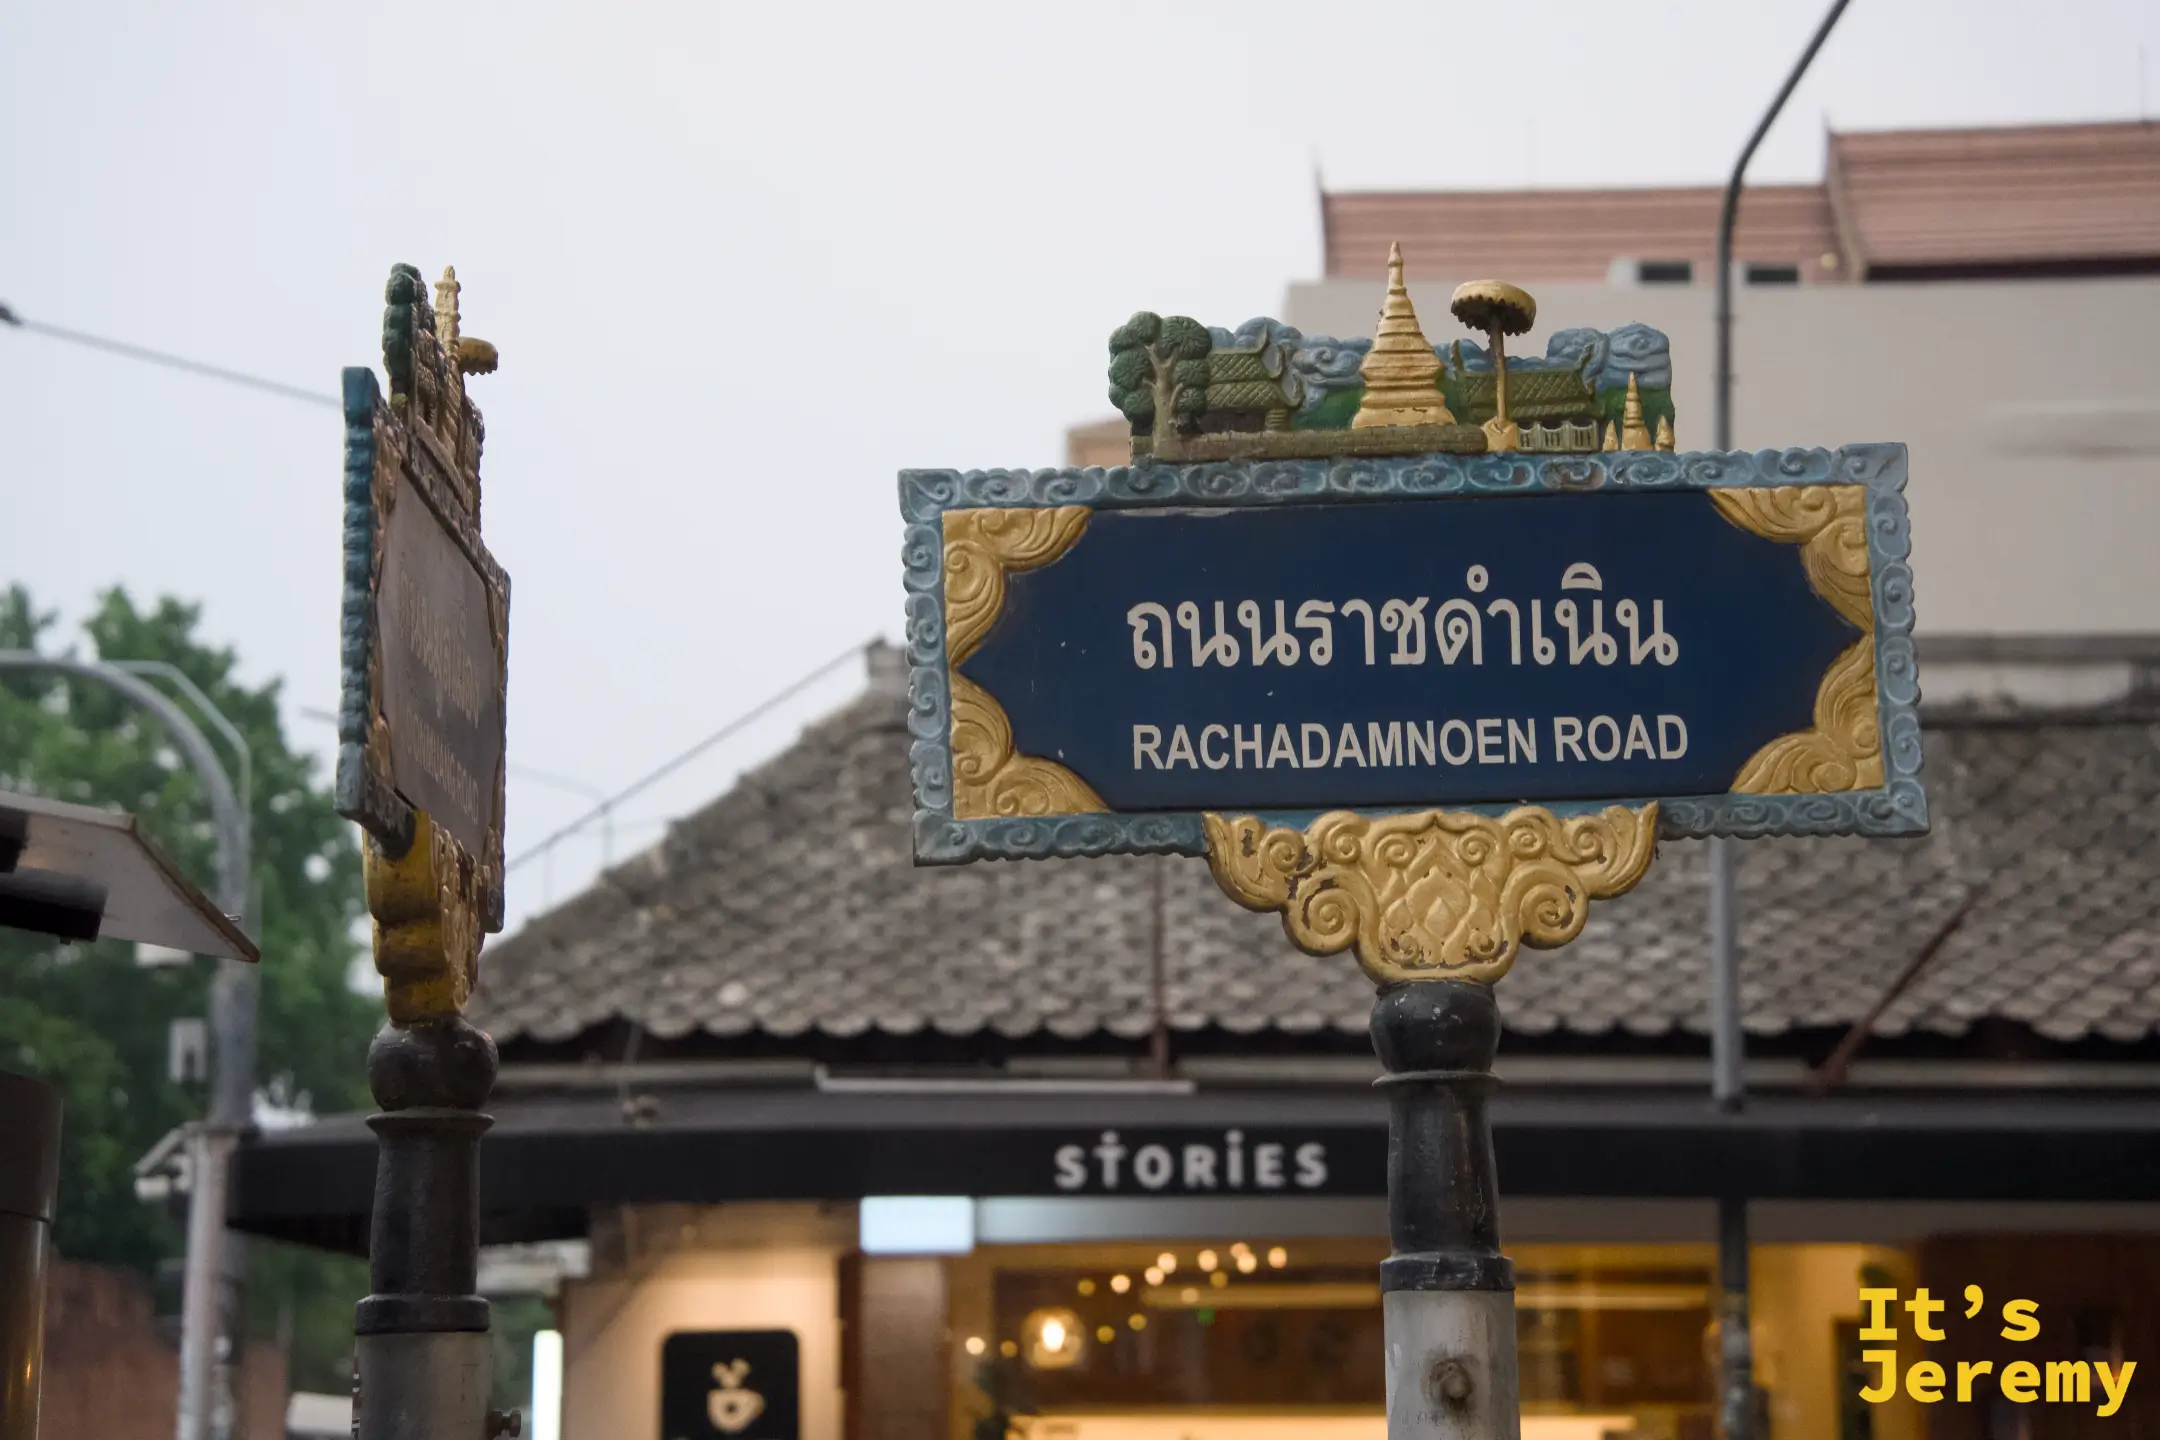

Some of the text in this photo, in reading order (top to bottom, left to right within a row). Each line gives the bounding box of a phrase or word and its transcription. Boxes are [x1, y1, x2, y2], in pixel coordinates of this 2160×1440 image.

[1127, 562, 1679, 669] ถนนราชดำเนิน
[1132, 714, 1688, 770] RACHADAMNOEN ROAD
